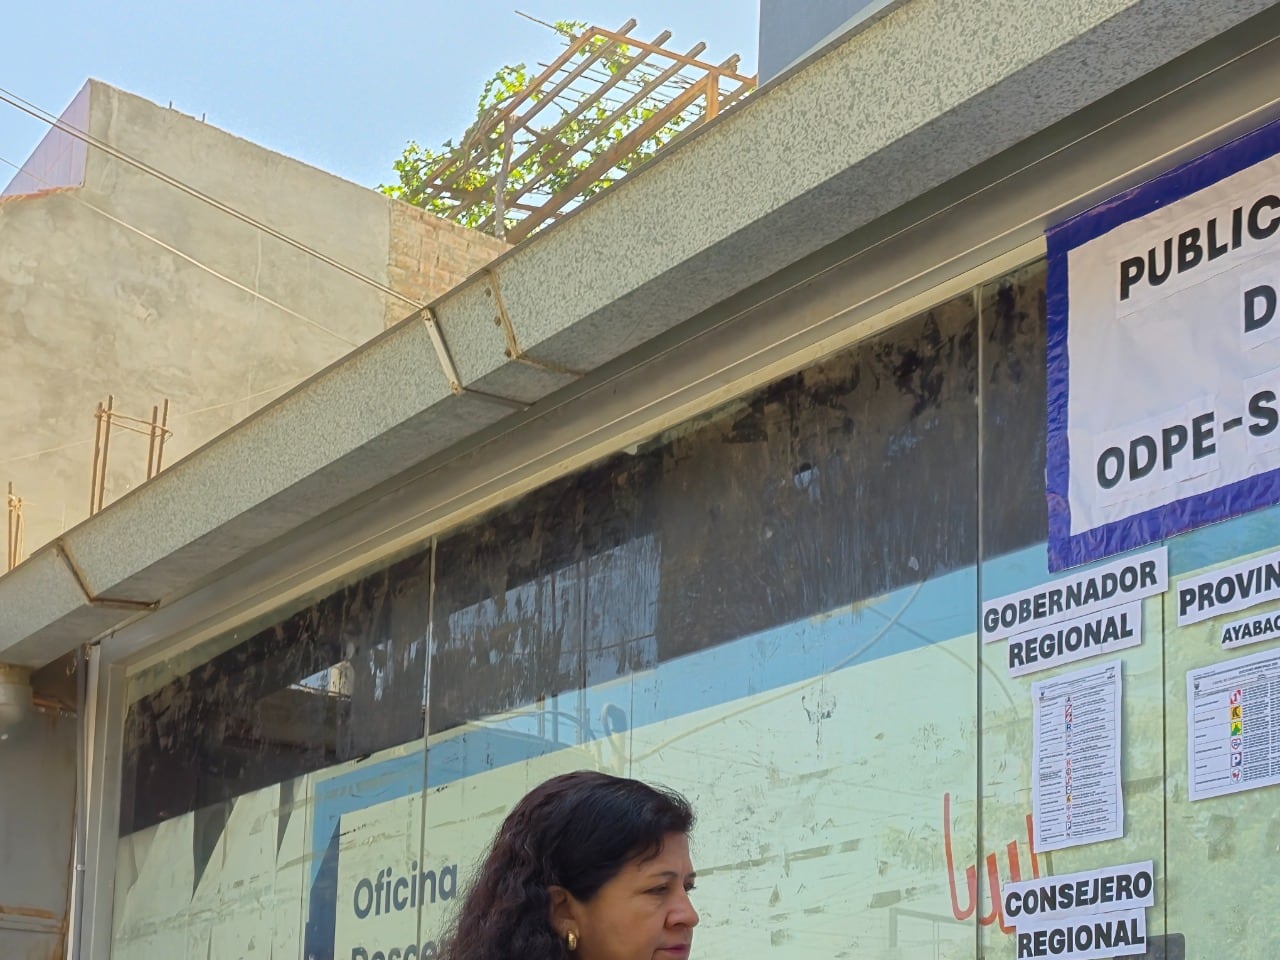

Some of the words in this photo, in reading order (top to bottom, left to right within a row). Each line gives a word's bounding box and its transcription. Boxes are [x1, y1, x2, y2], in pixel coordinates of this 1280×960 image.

[983, 560, 1158, 633] GOBERNADOR
[1008, 613, 1134, 669] REGIONAL
[353, 863, 458, 919] Oficina
[1004, 871, 1152, 918] CONSEJERO
[1018, 918, 1145, 959] REGIONAL
